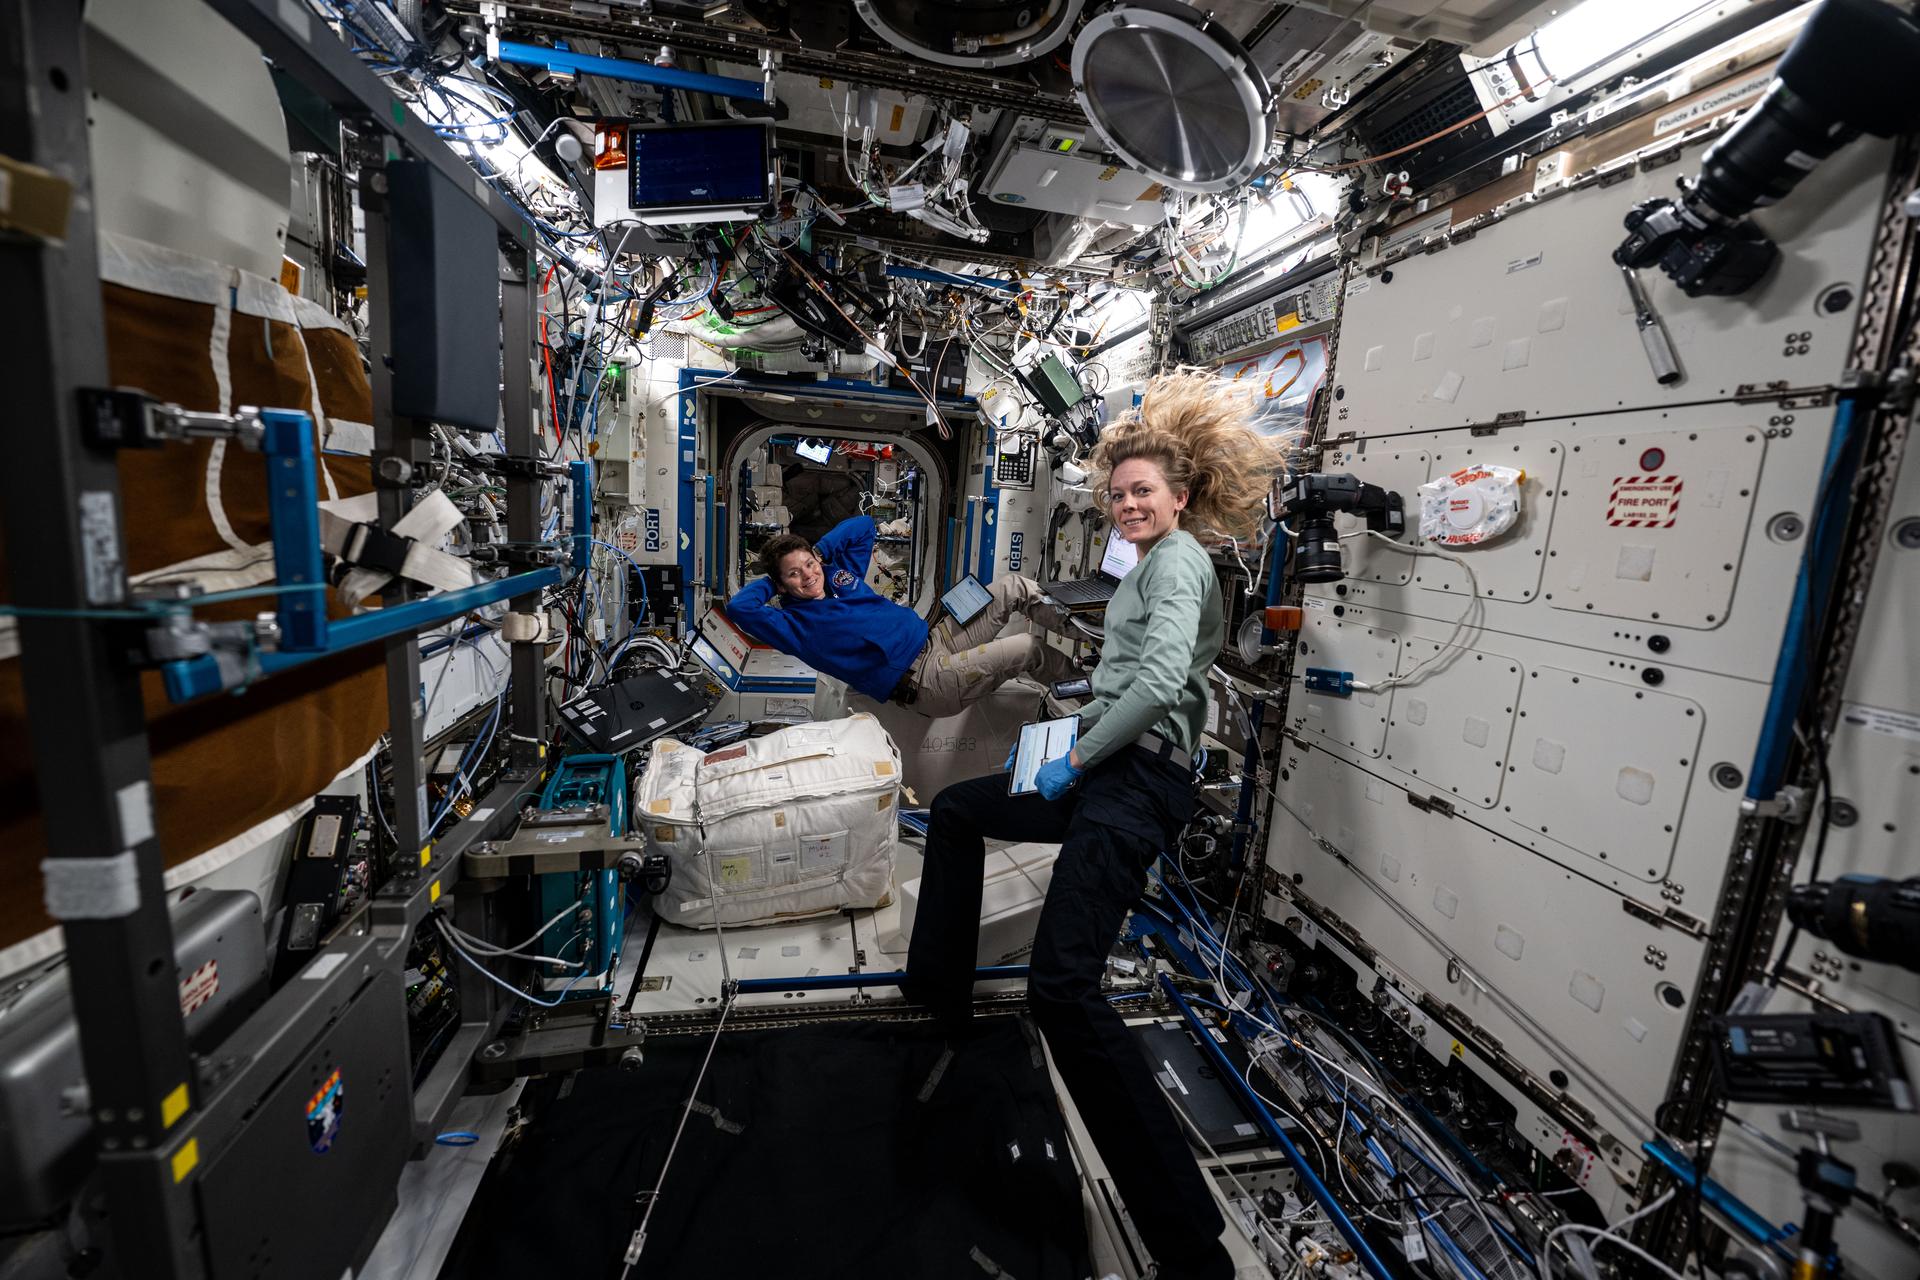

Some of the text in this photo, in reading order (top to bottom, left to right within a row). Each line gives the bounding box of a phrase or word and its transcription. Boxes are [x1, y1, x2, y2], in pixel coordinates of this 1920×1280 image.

[1658, 77, 1770, 130] Fluids & Combustion
[1618, 498, 1669, 507] FIRE PORT
[646, 509, 659, 550] PORT
[1010, 534, 1023, 570] STBD
